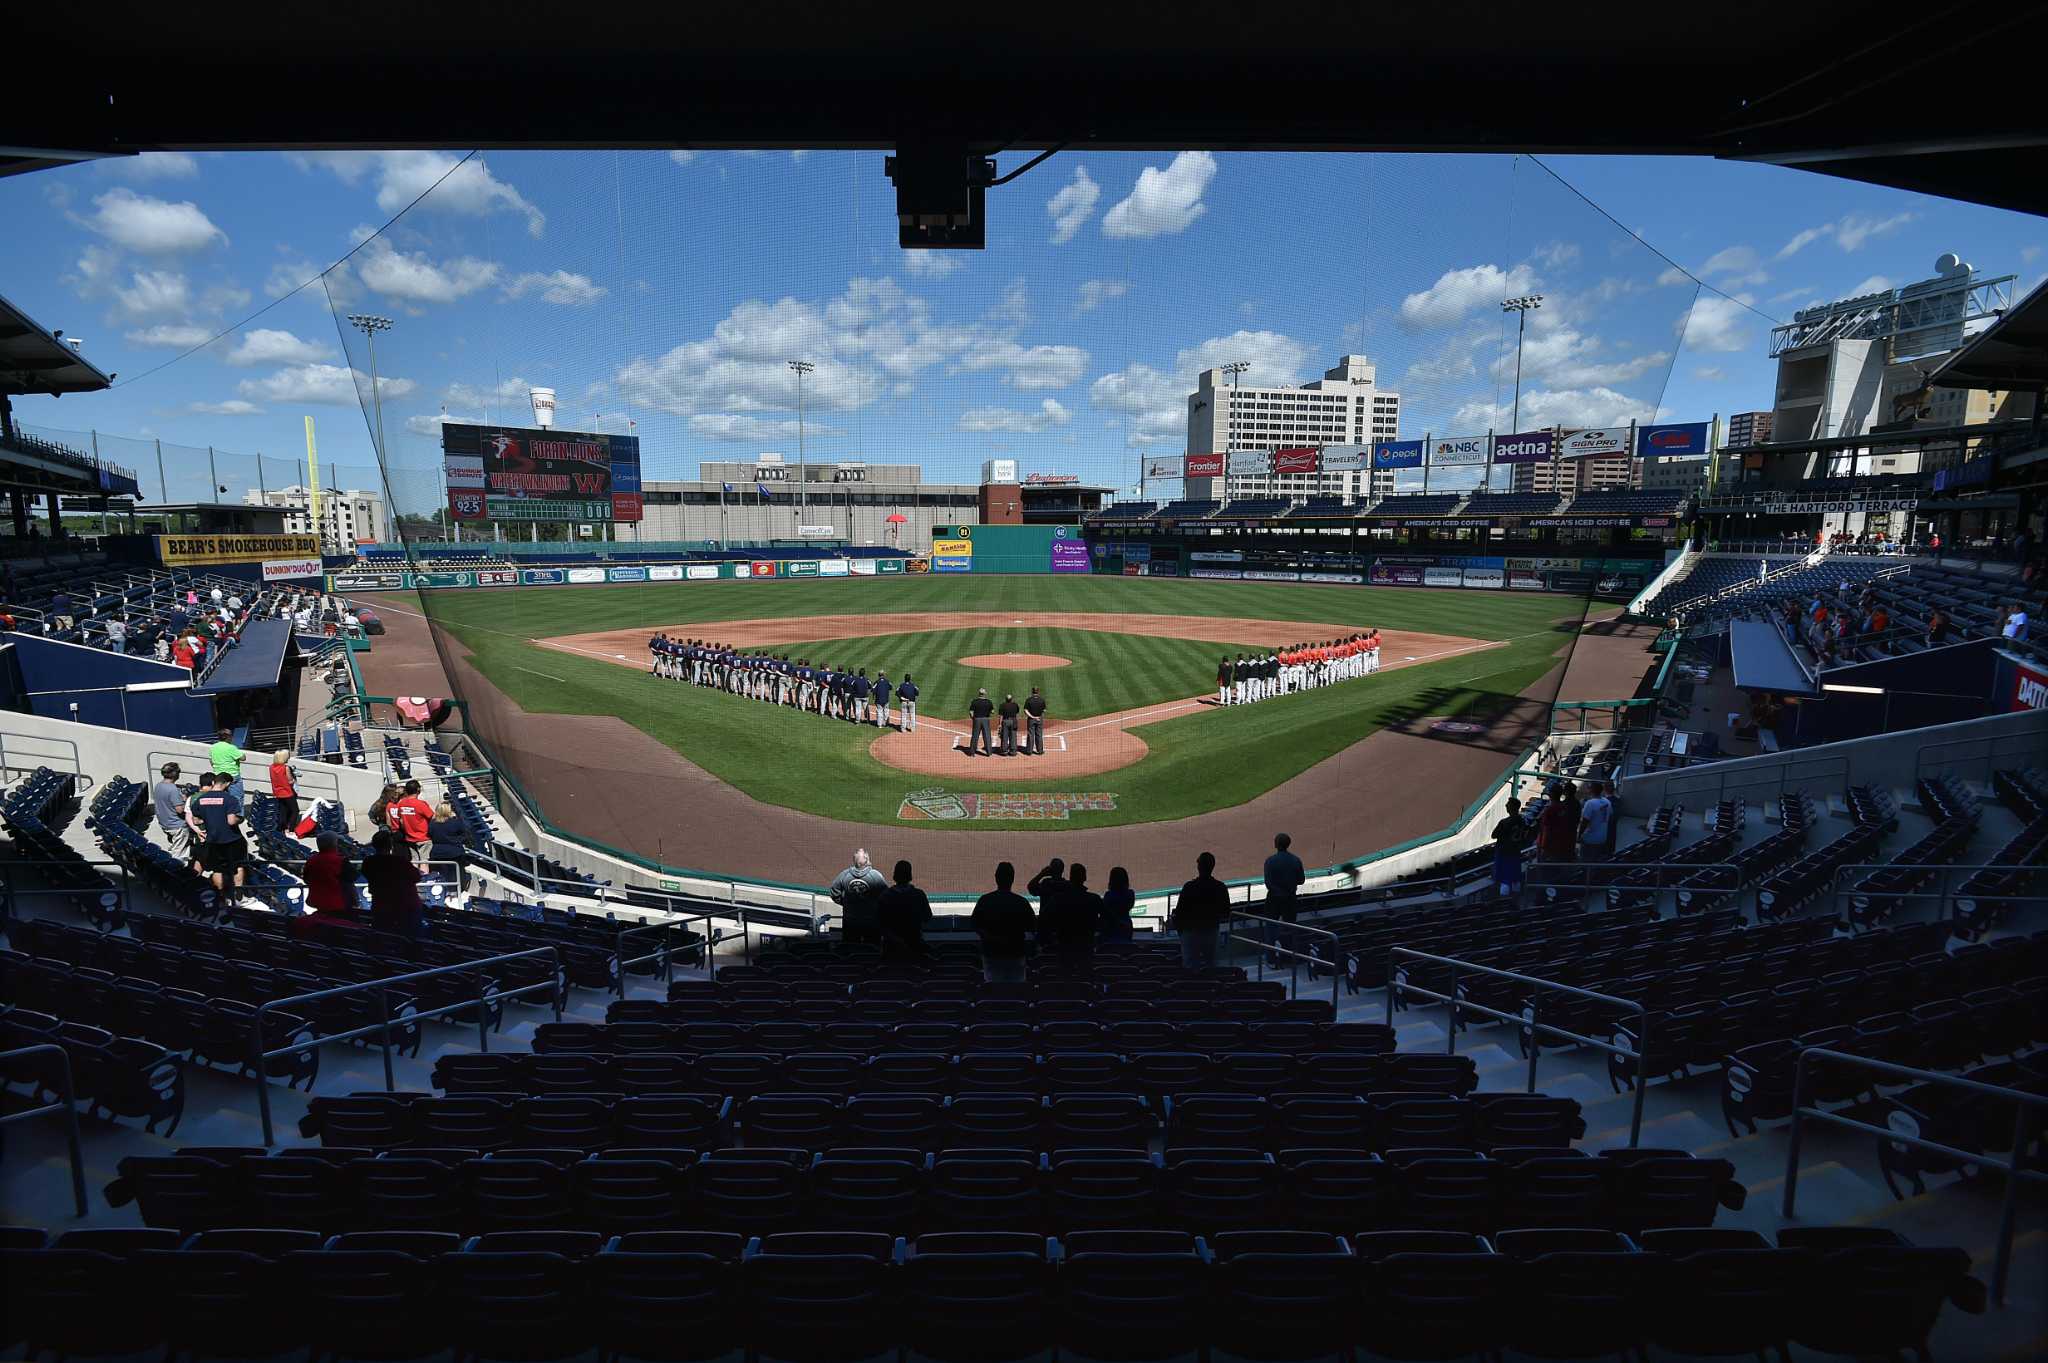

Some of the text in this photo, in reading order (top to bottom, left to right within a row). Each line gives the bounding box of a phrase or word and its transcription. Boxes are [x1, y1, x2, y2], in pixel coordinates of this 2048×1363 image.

[1455, 442, 1480, 453] NBC
[1496, 440, 1547, 456] aetna
[1595, 439, 1618, 447] PRO
[529, 440, 568, 459] FORAN
[1393, 448, 1418, 460] pepsi
[1325, 455, 1359, 464] TRAVELERS
[1434, 453, 1481, 462] CONNECTICUT
[1188, 460, 1220, 472] Frontier
[455, 494, 482, 502] COUNTRY
[587, 506, 611, 519] 0 0 0
[1767, 500, 1915, 513] THE HARTFORD TERRACE
[1404, 518, 1490, 526] AMERICA'S ICED COFFEE
[1529, 518, 1631, 526] AMERICA'S ICED COFFEE
[168, 538, 316, 556] BEAR'S SMOKEHOUSE BBQ
[265, 562, 321, 575] DUNKIN' DUGOUT
